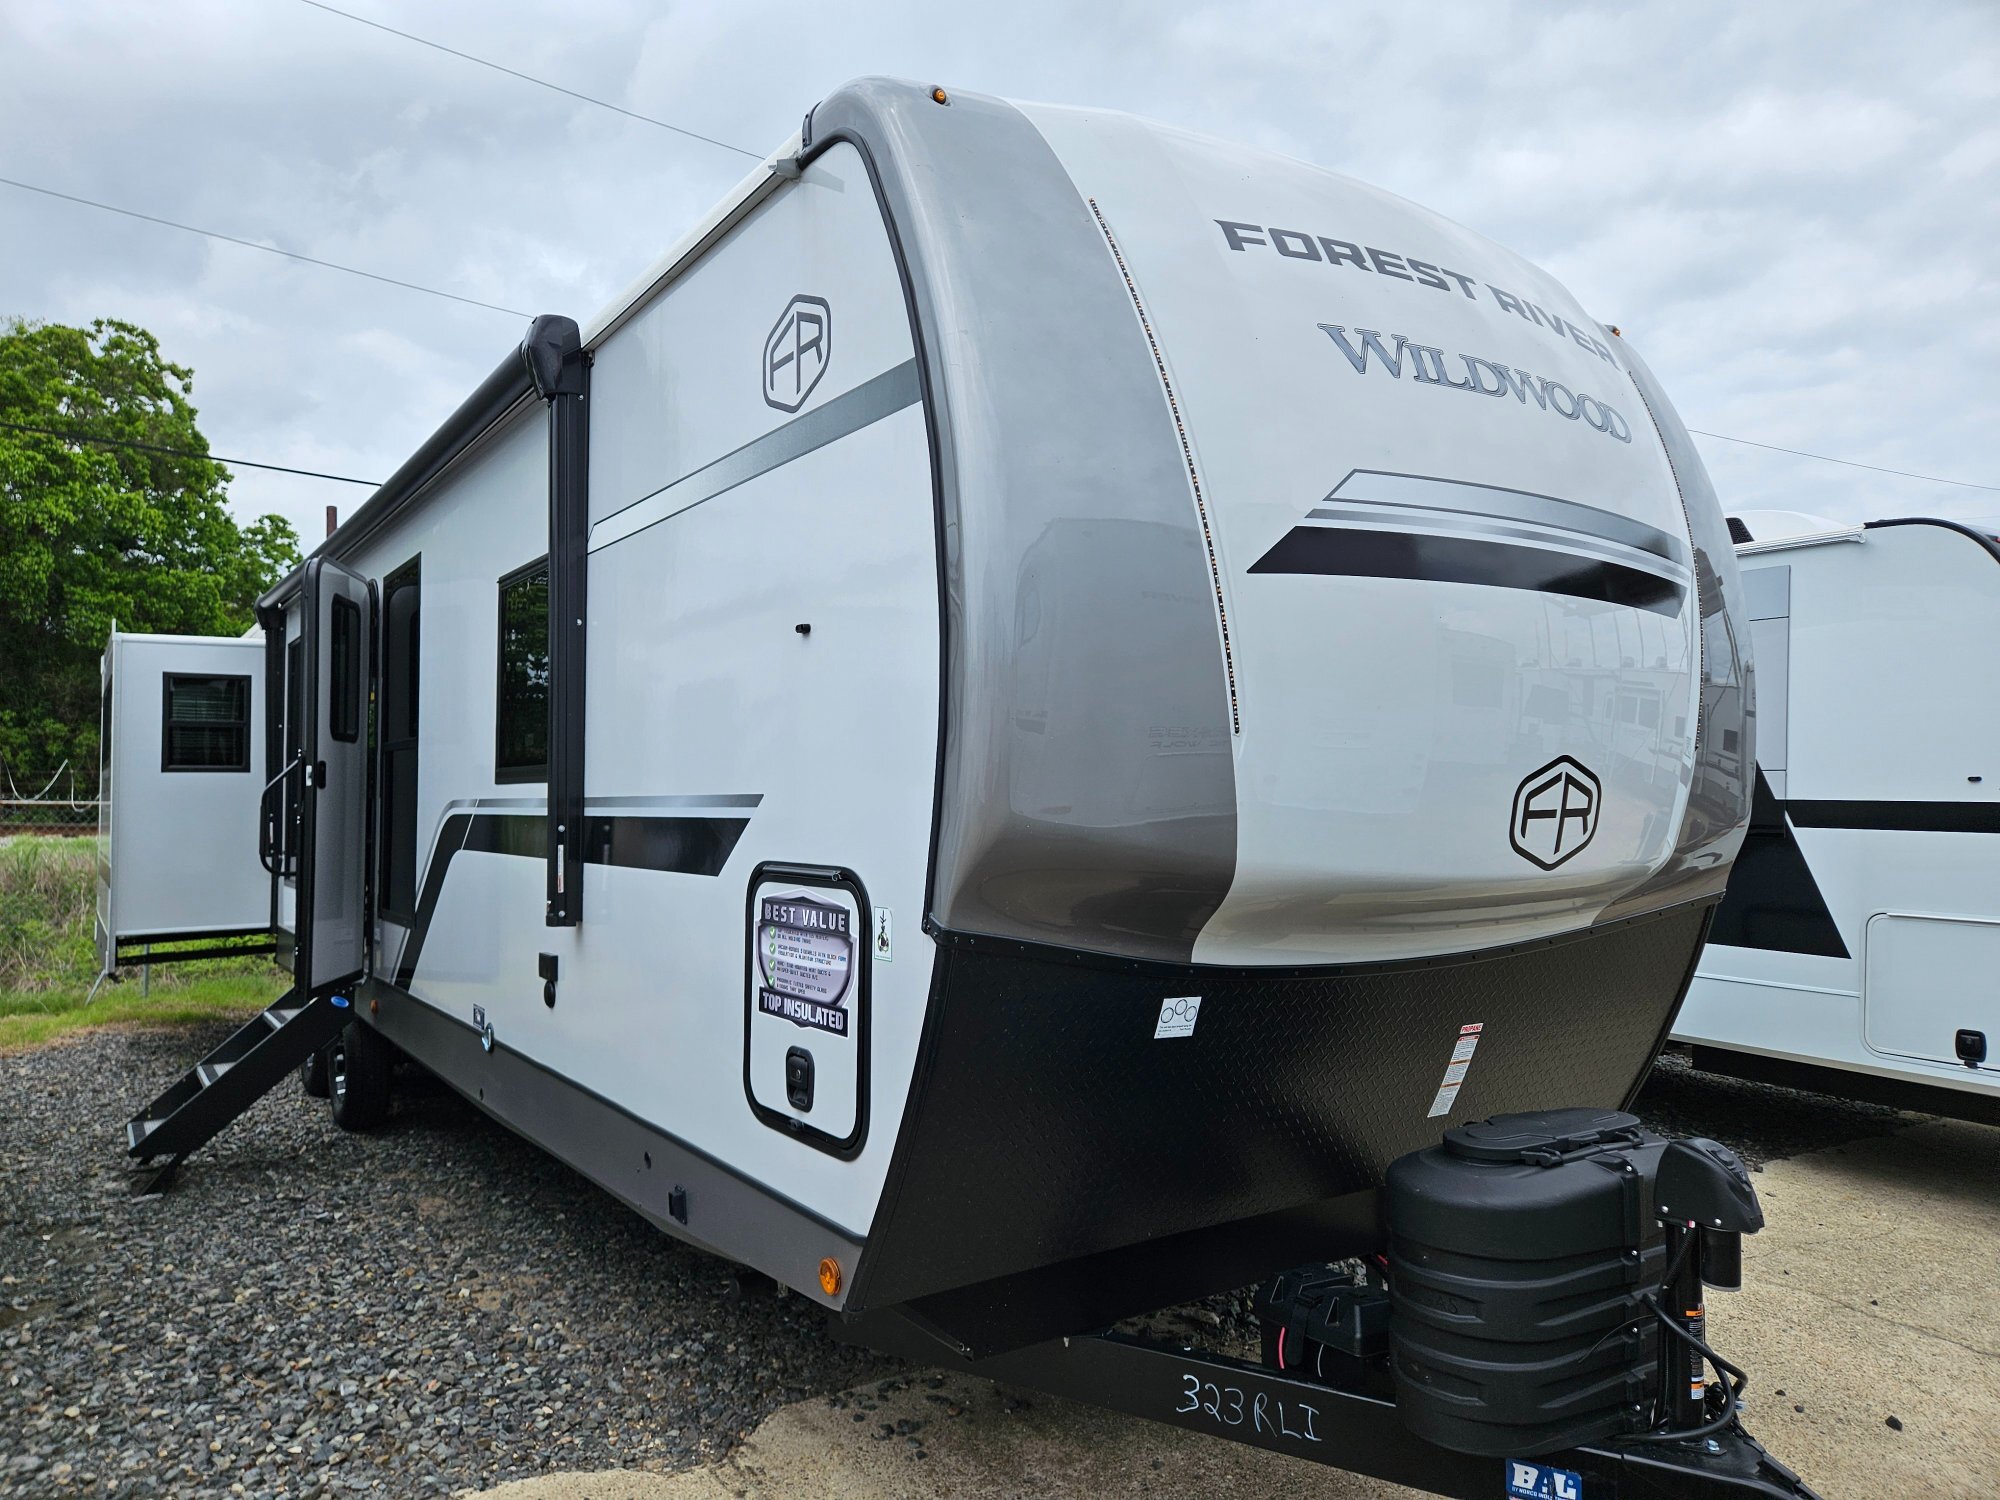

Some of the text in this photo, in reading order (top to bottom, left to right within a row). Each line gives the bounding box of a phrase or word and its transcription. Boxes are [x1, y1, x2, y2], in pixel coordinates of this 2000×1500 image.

[1213, 218, 1622, 373] FOREST RIVER
[1317, 323, 1632, 444] WILDWOOD
[764, 903, 846, 932] BEST VALUE
[762, 991, 844, 1031] TOP INSULATED
[1462, 1025, 1481, 1033] PROPANE
[1175, 1374, 1323, 1442] 323RLI
[1519, 1488, 1538, 1498] NORCO
